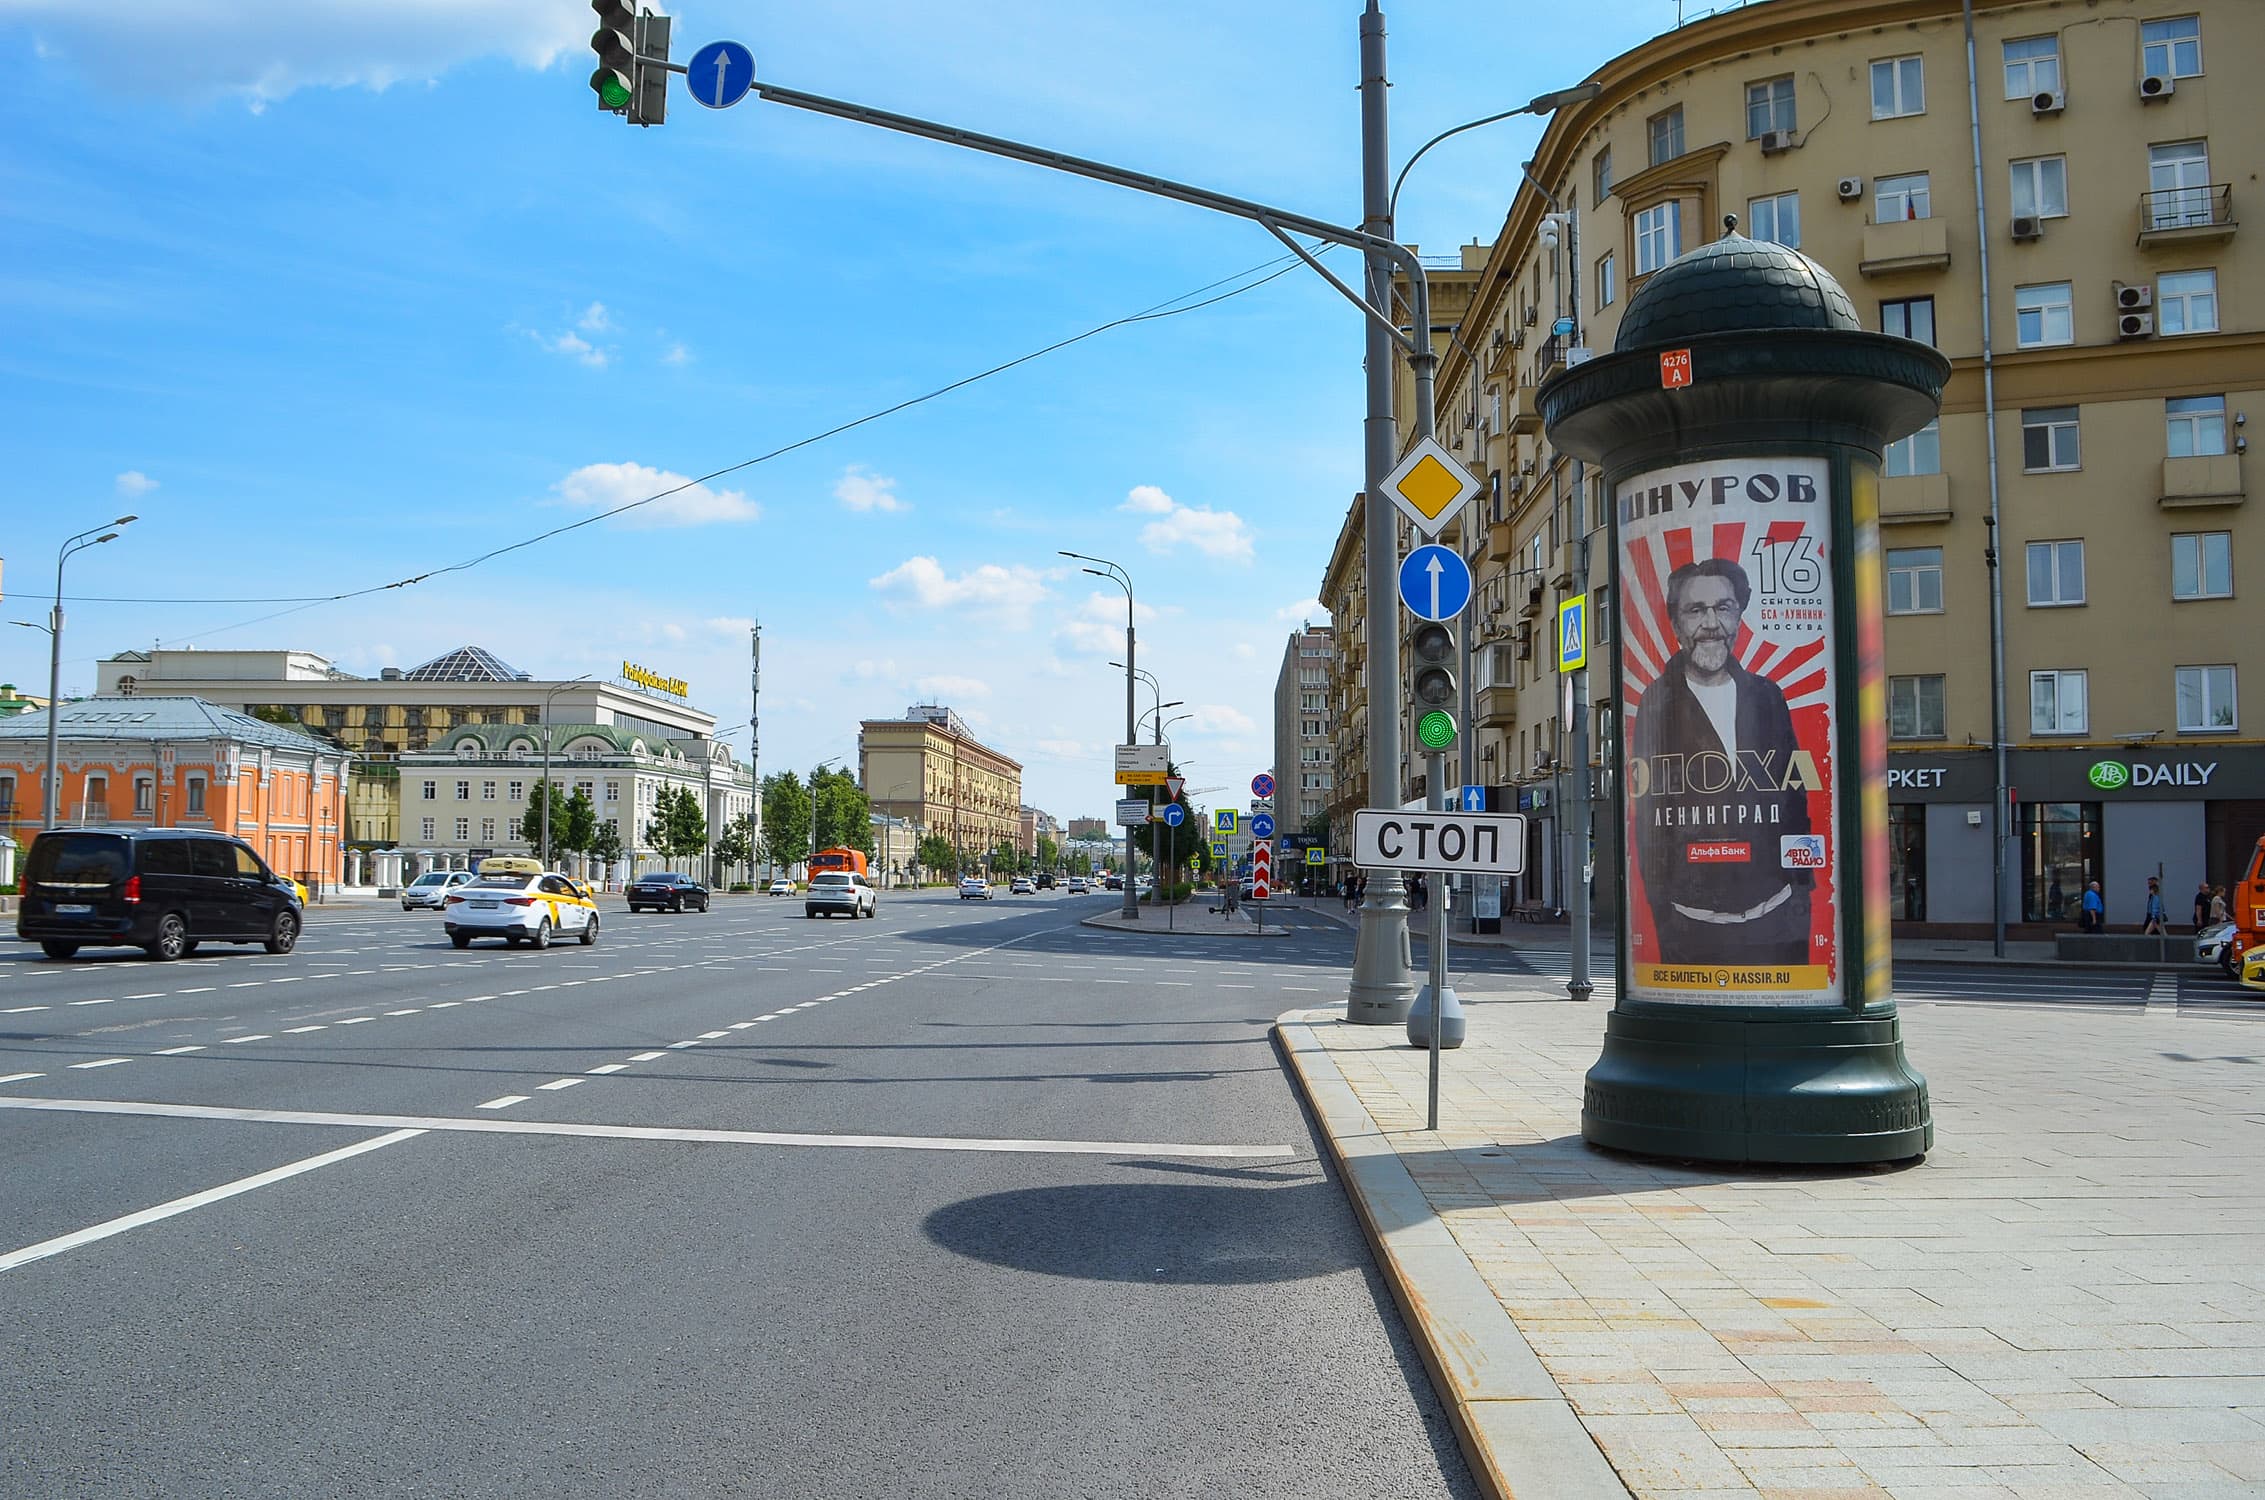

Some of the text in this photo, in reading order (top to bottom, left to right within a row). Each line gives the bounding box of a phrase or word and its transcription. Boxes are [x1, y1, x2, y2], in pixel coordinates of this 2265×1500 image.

[1663, 355, 1687, 367] 4276
[1620, 474, 1817, 525] ШНУРОВ
[1752, 537, 1821, 594] 16
[1761, 609, 1777, 619] БСА
[669, 677, 688, 697] БАНК
[1627, 750, 1823, 799] ЭПОХА
[1888, 768, 1948, 787] РКЕТ
[2132, 762, 2217, 786] DAILY
[1655, 804, 1780, 826] ЛЕНИНГРАД
[1378, 821, 1498, 863] СТОП
[1691, 846, 1746, 857] Альфа Банк
[1784, 849, 1811, 858] АВТО
[1792, 857, 1824, 866] РАДИО
[1815, 935, 1828, 946] 18+
[1653, 969, 1790, 984] ВСЕ БИЛЕТЫ KASSIR.RU
